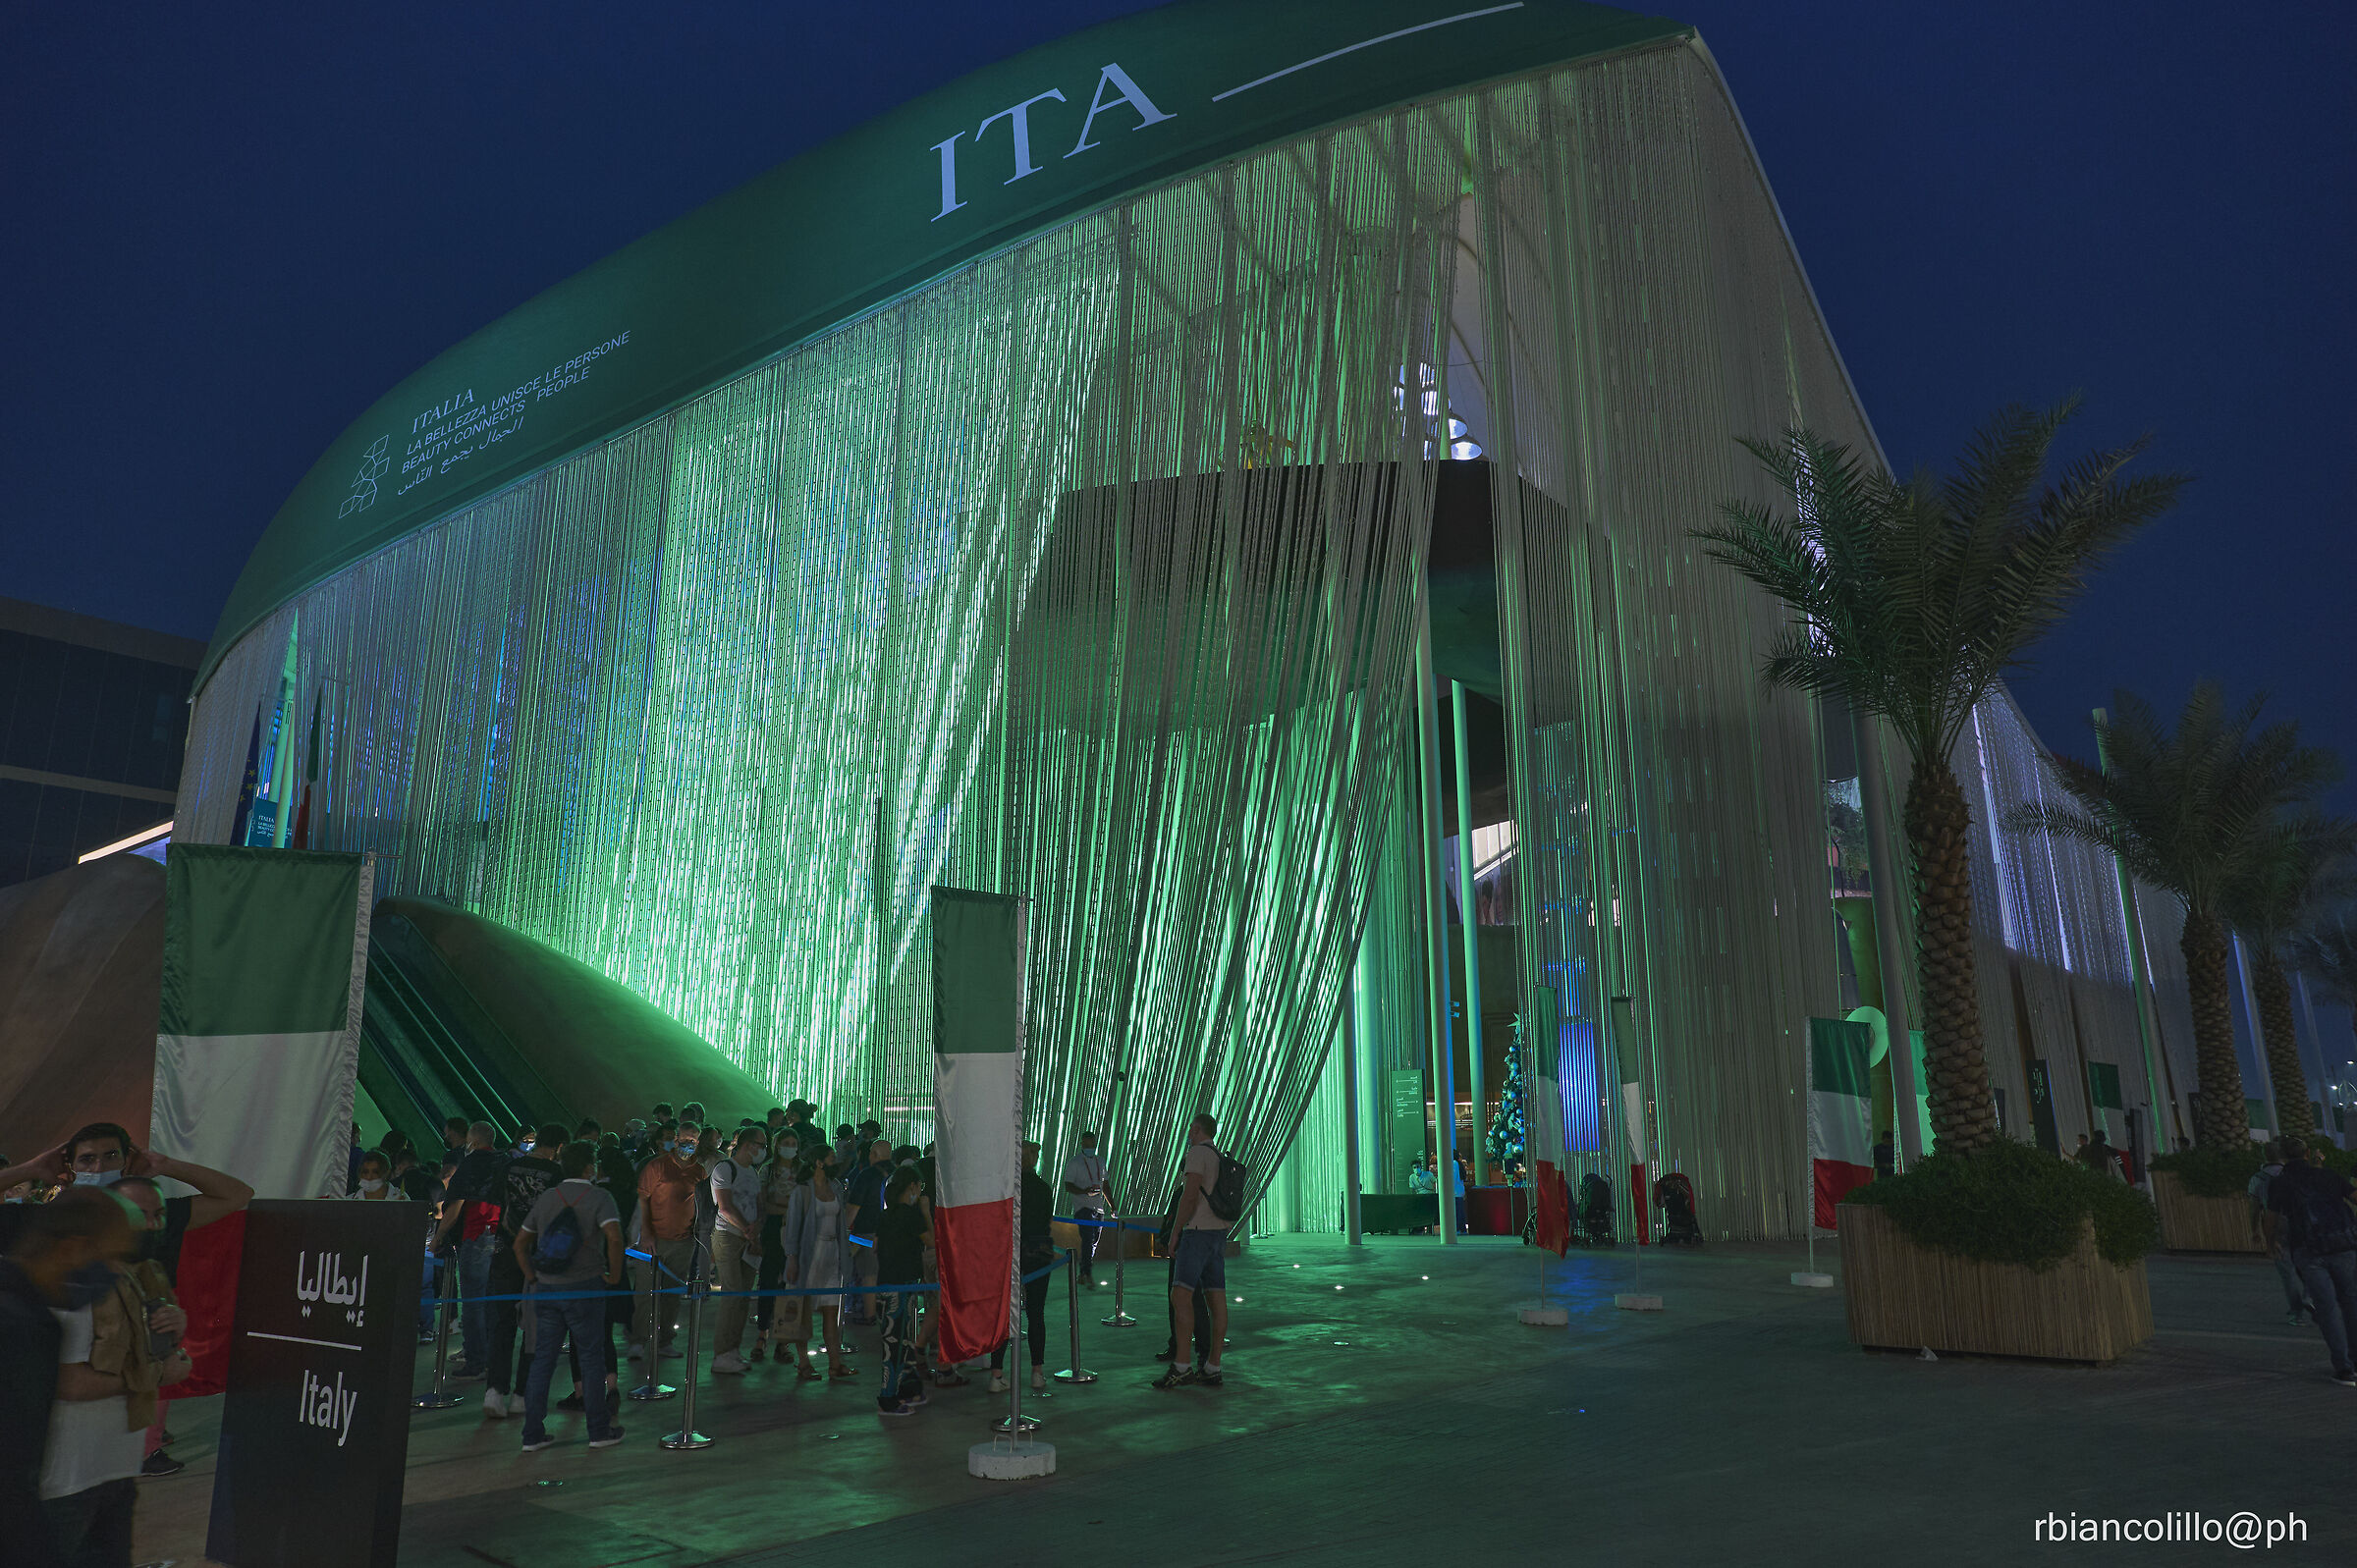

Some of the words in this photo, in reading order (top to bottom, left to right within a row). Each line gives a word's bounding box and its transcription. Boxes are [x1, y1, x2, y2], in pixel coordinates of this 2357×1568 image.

[929, 63, 1178, 223] ITA
[401, 436, 453, 474] BEAUTY
[454, 400, 526, 445] CONNECTS
[536, 366, 590, 402] PEOPLE
[407, 440, 422, 456] LA
[424, 405, 487, 446] BELLEZZA
[491, 376, 542, 411] UNISCE
[545, 365, 563, 384] LE
[565, 330, 631, 374] PERSONE
[411, 389, 474, 434] ITALIA
[440, 446, 473, 474] يجمع
[478, 415, 524, 450] الجمال
[297, 1250, 368, 1327] إيطاليا
[299, 1370, 357, 1447] Italy
